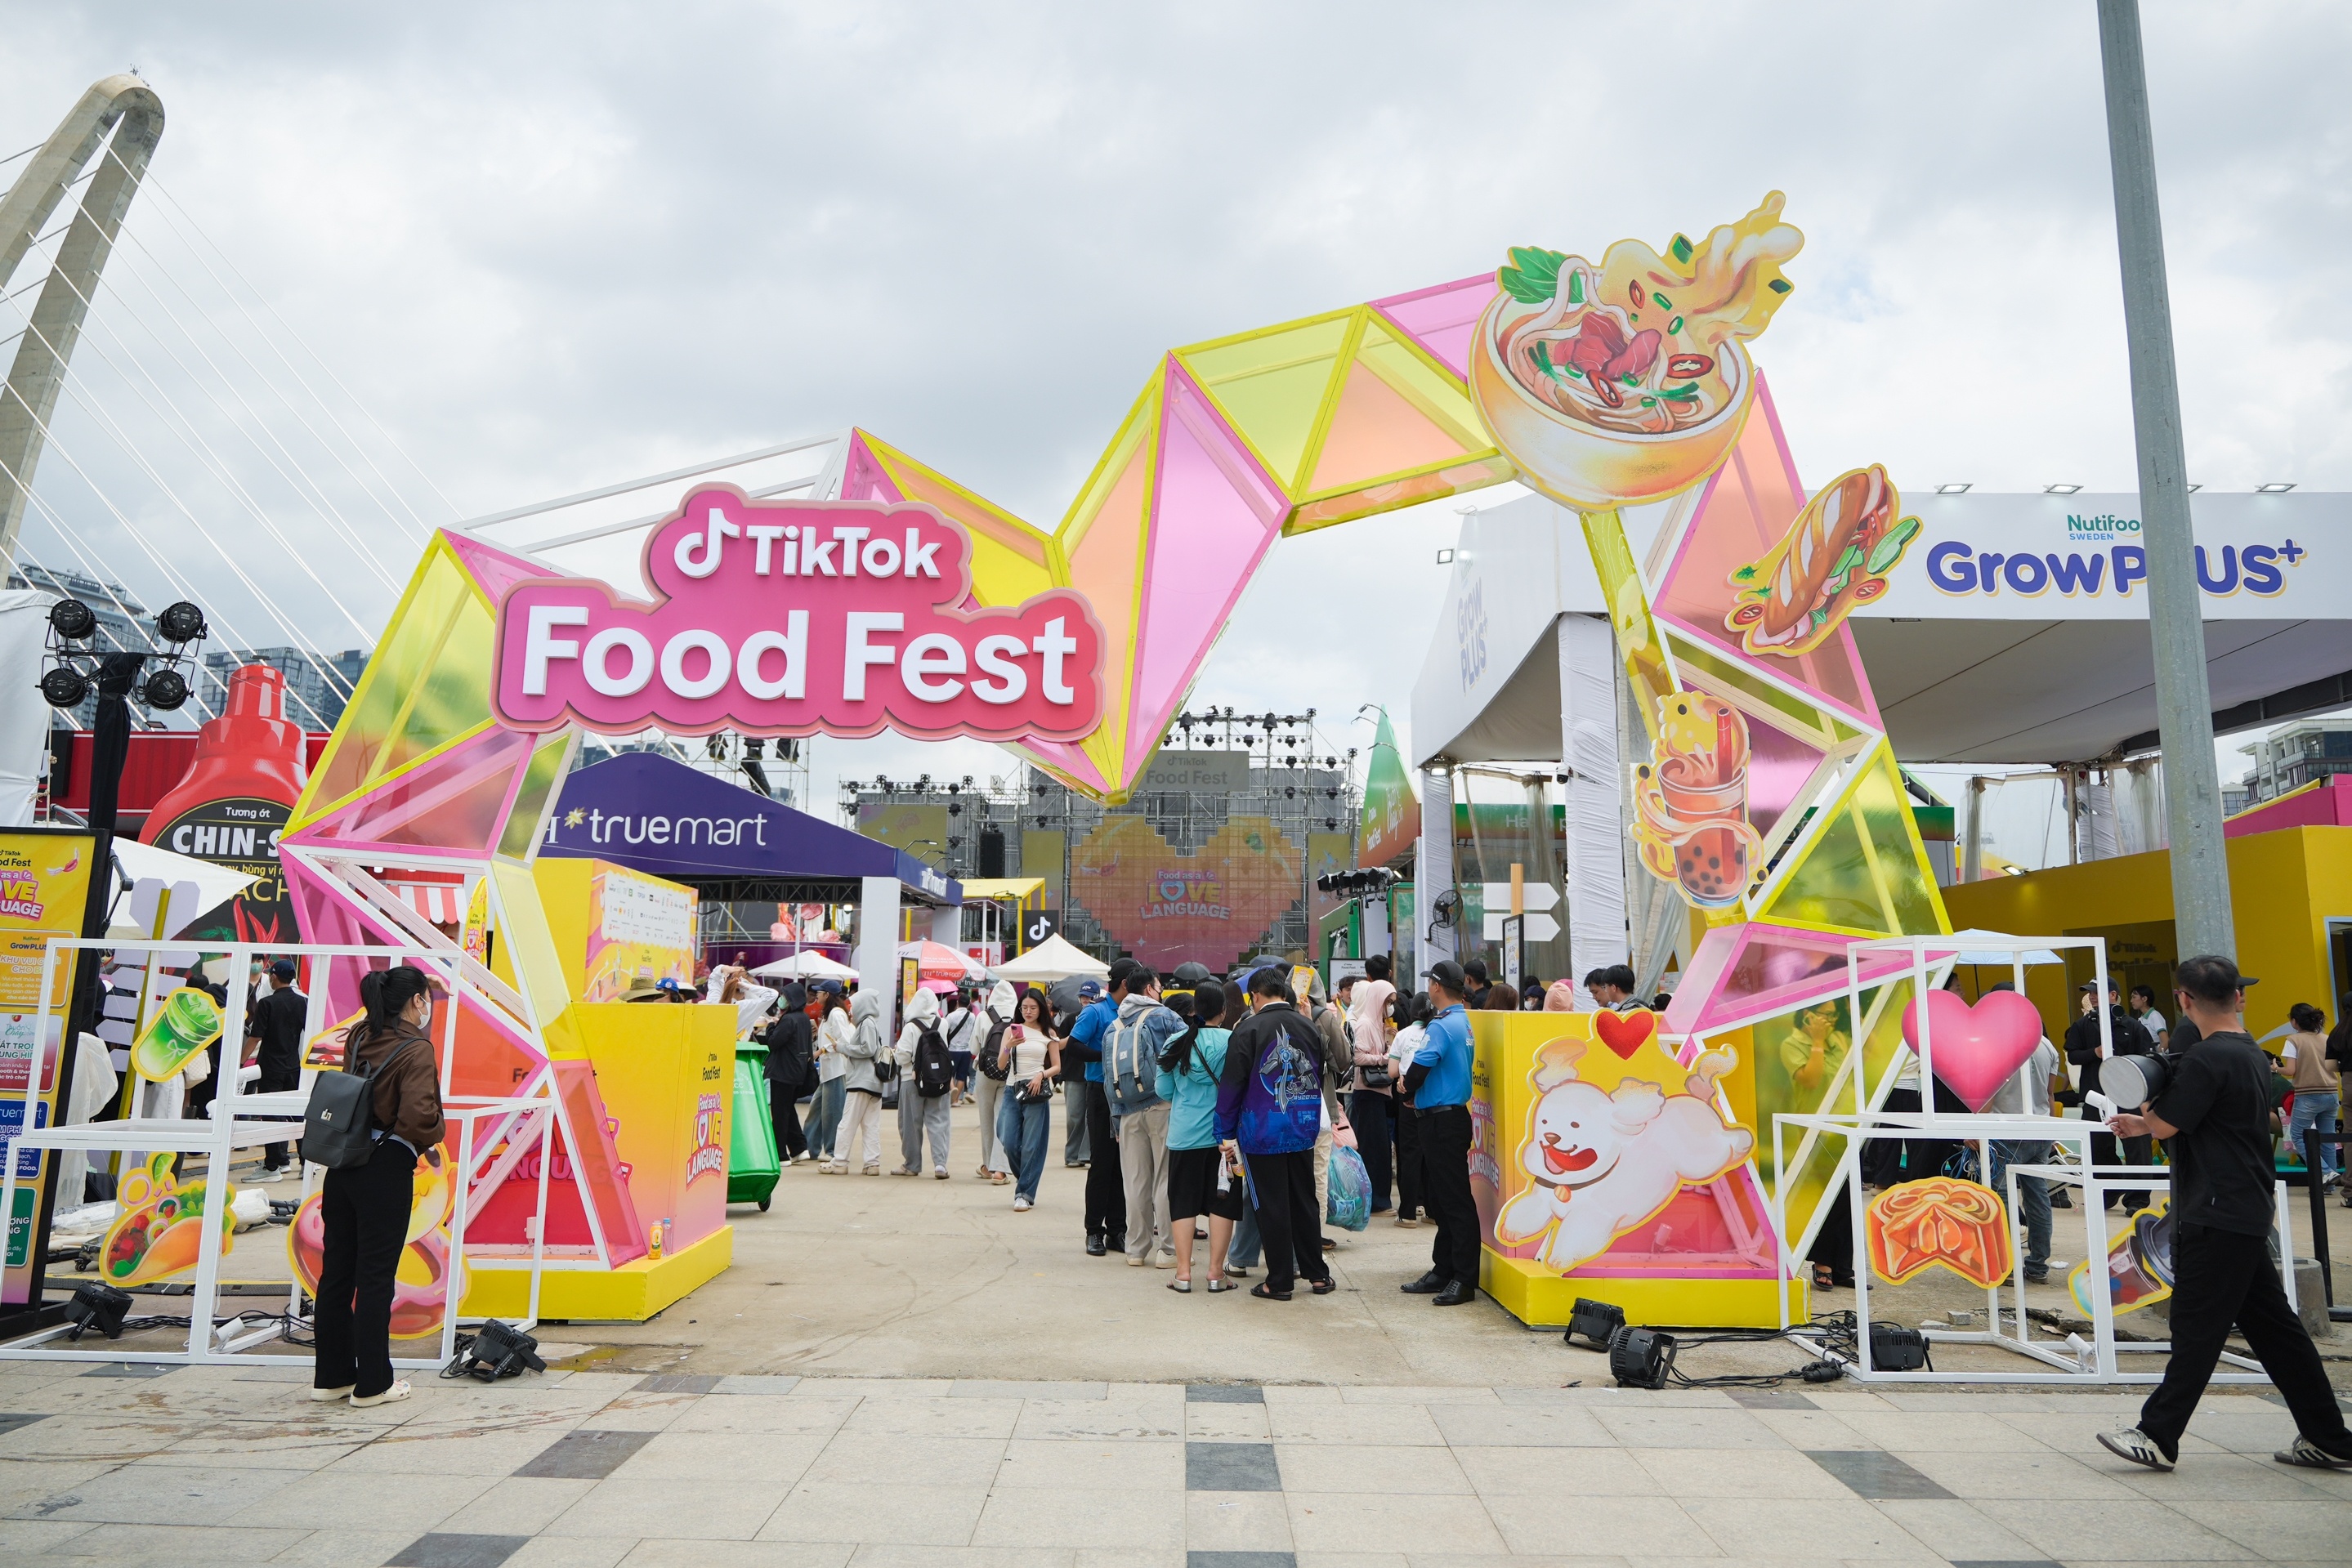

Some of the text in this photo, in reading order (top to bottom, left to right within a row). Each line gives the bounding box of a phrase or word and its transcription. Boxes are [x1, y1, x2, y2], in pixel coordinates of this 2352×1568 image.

[2068, 514, 2143, 533] Nutifoo
[746, 525, 942, 579] TikTok
[1926, 538, 2305, 595] GrowPUS+
[521, 605, 1077, 705] Food Fest
[1178, 757, 1208, 766] TikTok
[1146, 770, 1228, 784] Food Fest
[225, 806, 271, 820] Tương ớt
[11, 859, 31, 867] Fest
[1158, 871, 1180, 880] Food
[1182, 872, 1193, 880] as
[0, 879, 38, 901] VE
[1148, 881, 1223, 904] LOVE
[1140, 902, 1231, 921] LANGUAGE
[20, 957, 37, 965] VUI
[11, 966, 33, 974] CHO
[702, 1065, 721, 1082] Food Fest
[1481, 1073, 1490, 1088] Fest
[691, 1111, 722, 1155] LOVE
[686, 1147, 722, 1185] LANGUAGE
[494, 1366, 503, 1375] SVT
